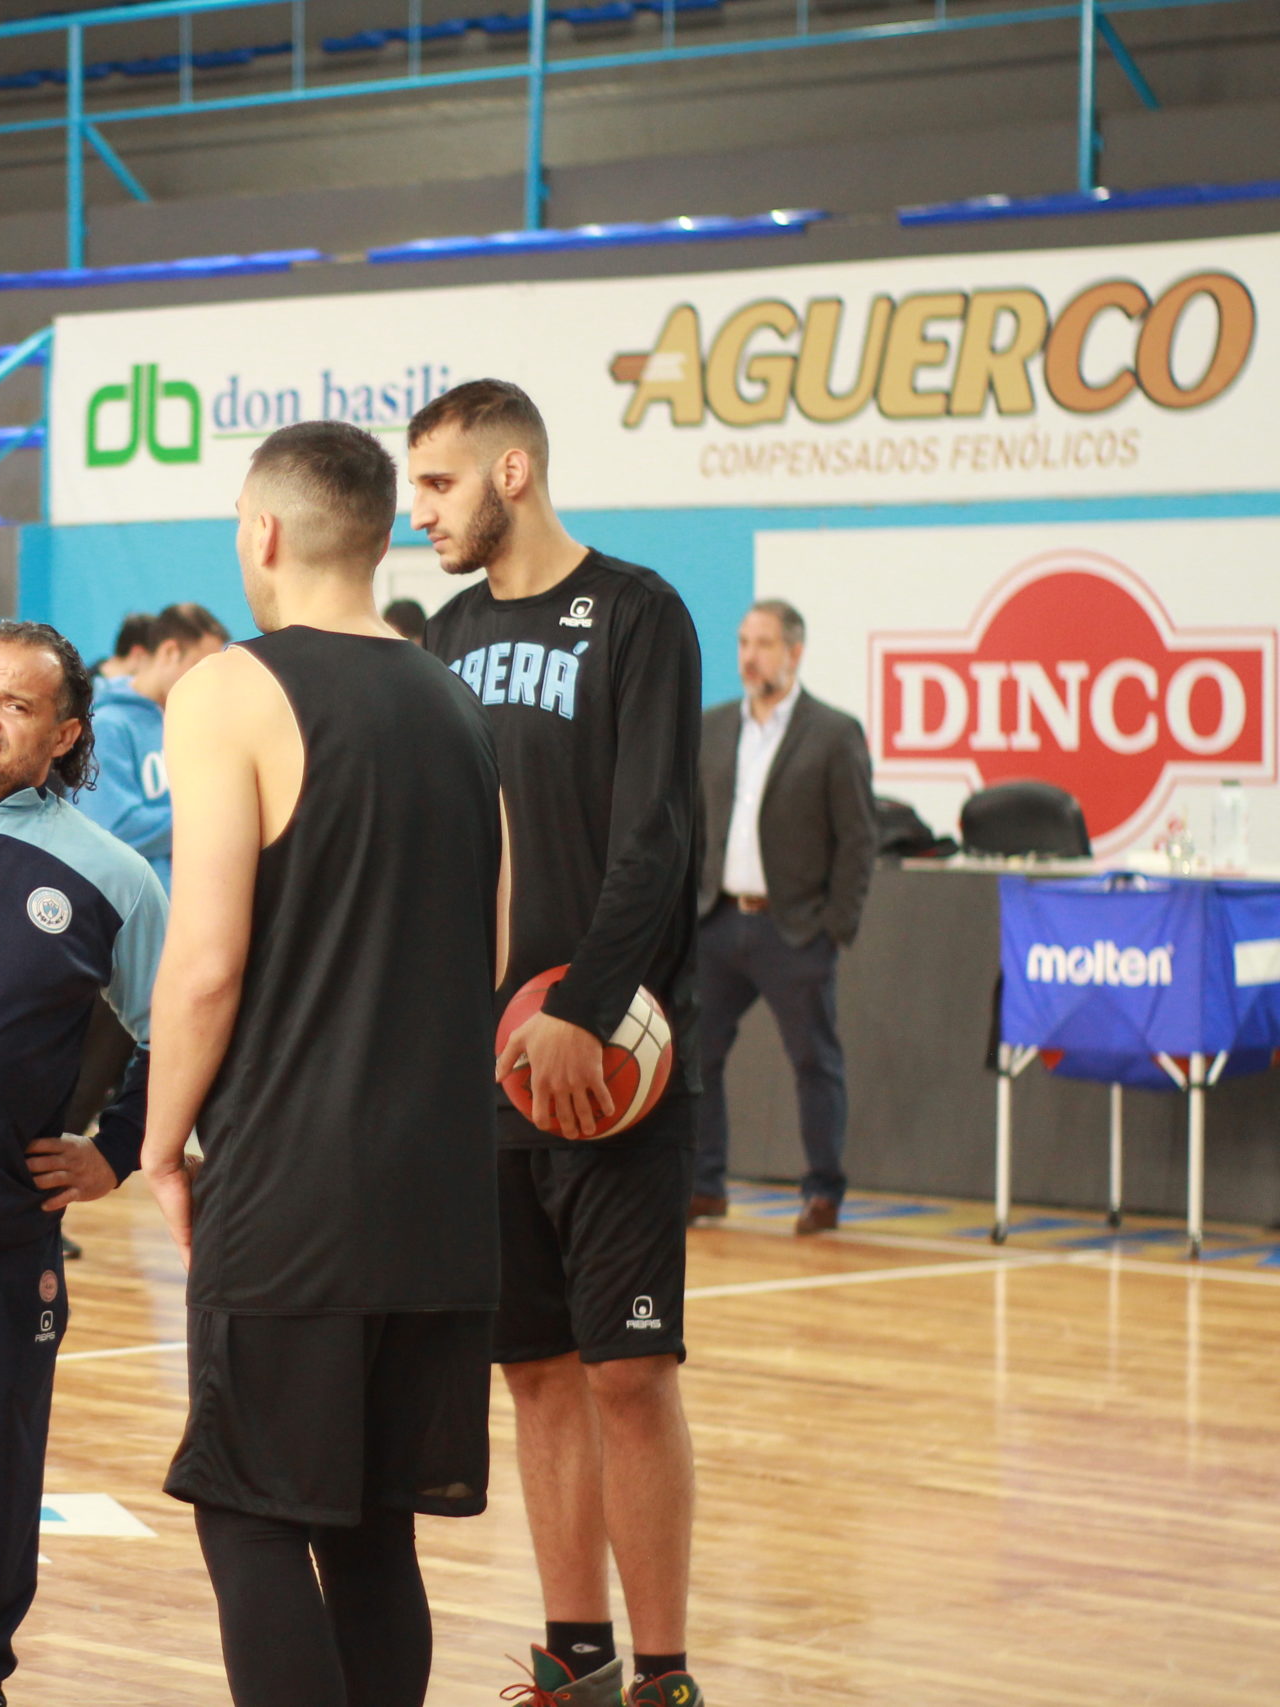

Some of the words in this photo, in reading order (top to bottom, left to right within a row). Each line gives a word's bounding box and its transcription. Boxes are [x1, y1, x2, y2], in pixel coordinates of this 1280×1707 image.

[622, 271, 1257, 428] AGUERCO
[213, 375, 301, 429] don
[699, 436, 941, 478] COMPENSADOS
[949, 425, 1141, 471] FENÓLICOS
[449, 640, 589, 720] BERÁ
[893, 658, 1247, 756] DINCO
[1026, 940, 1173, 987] molten
